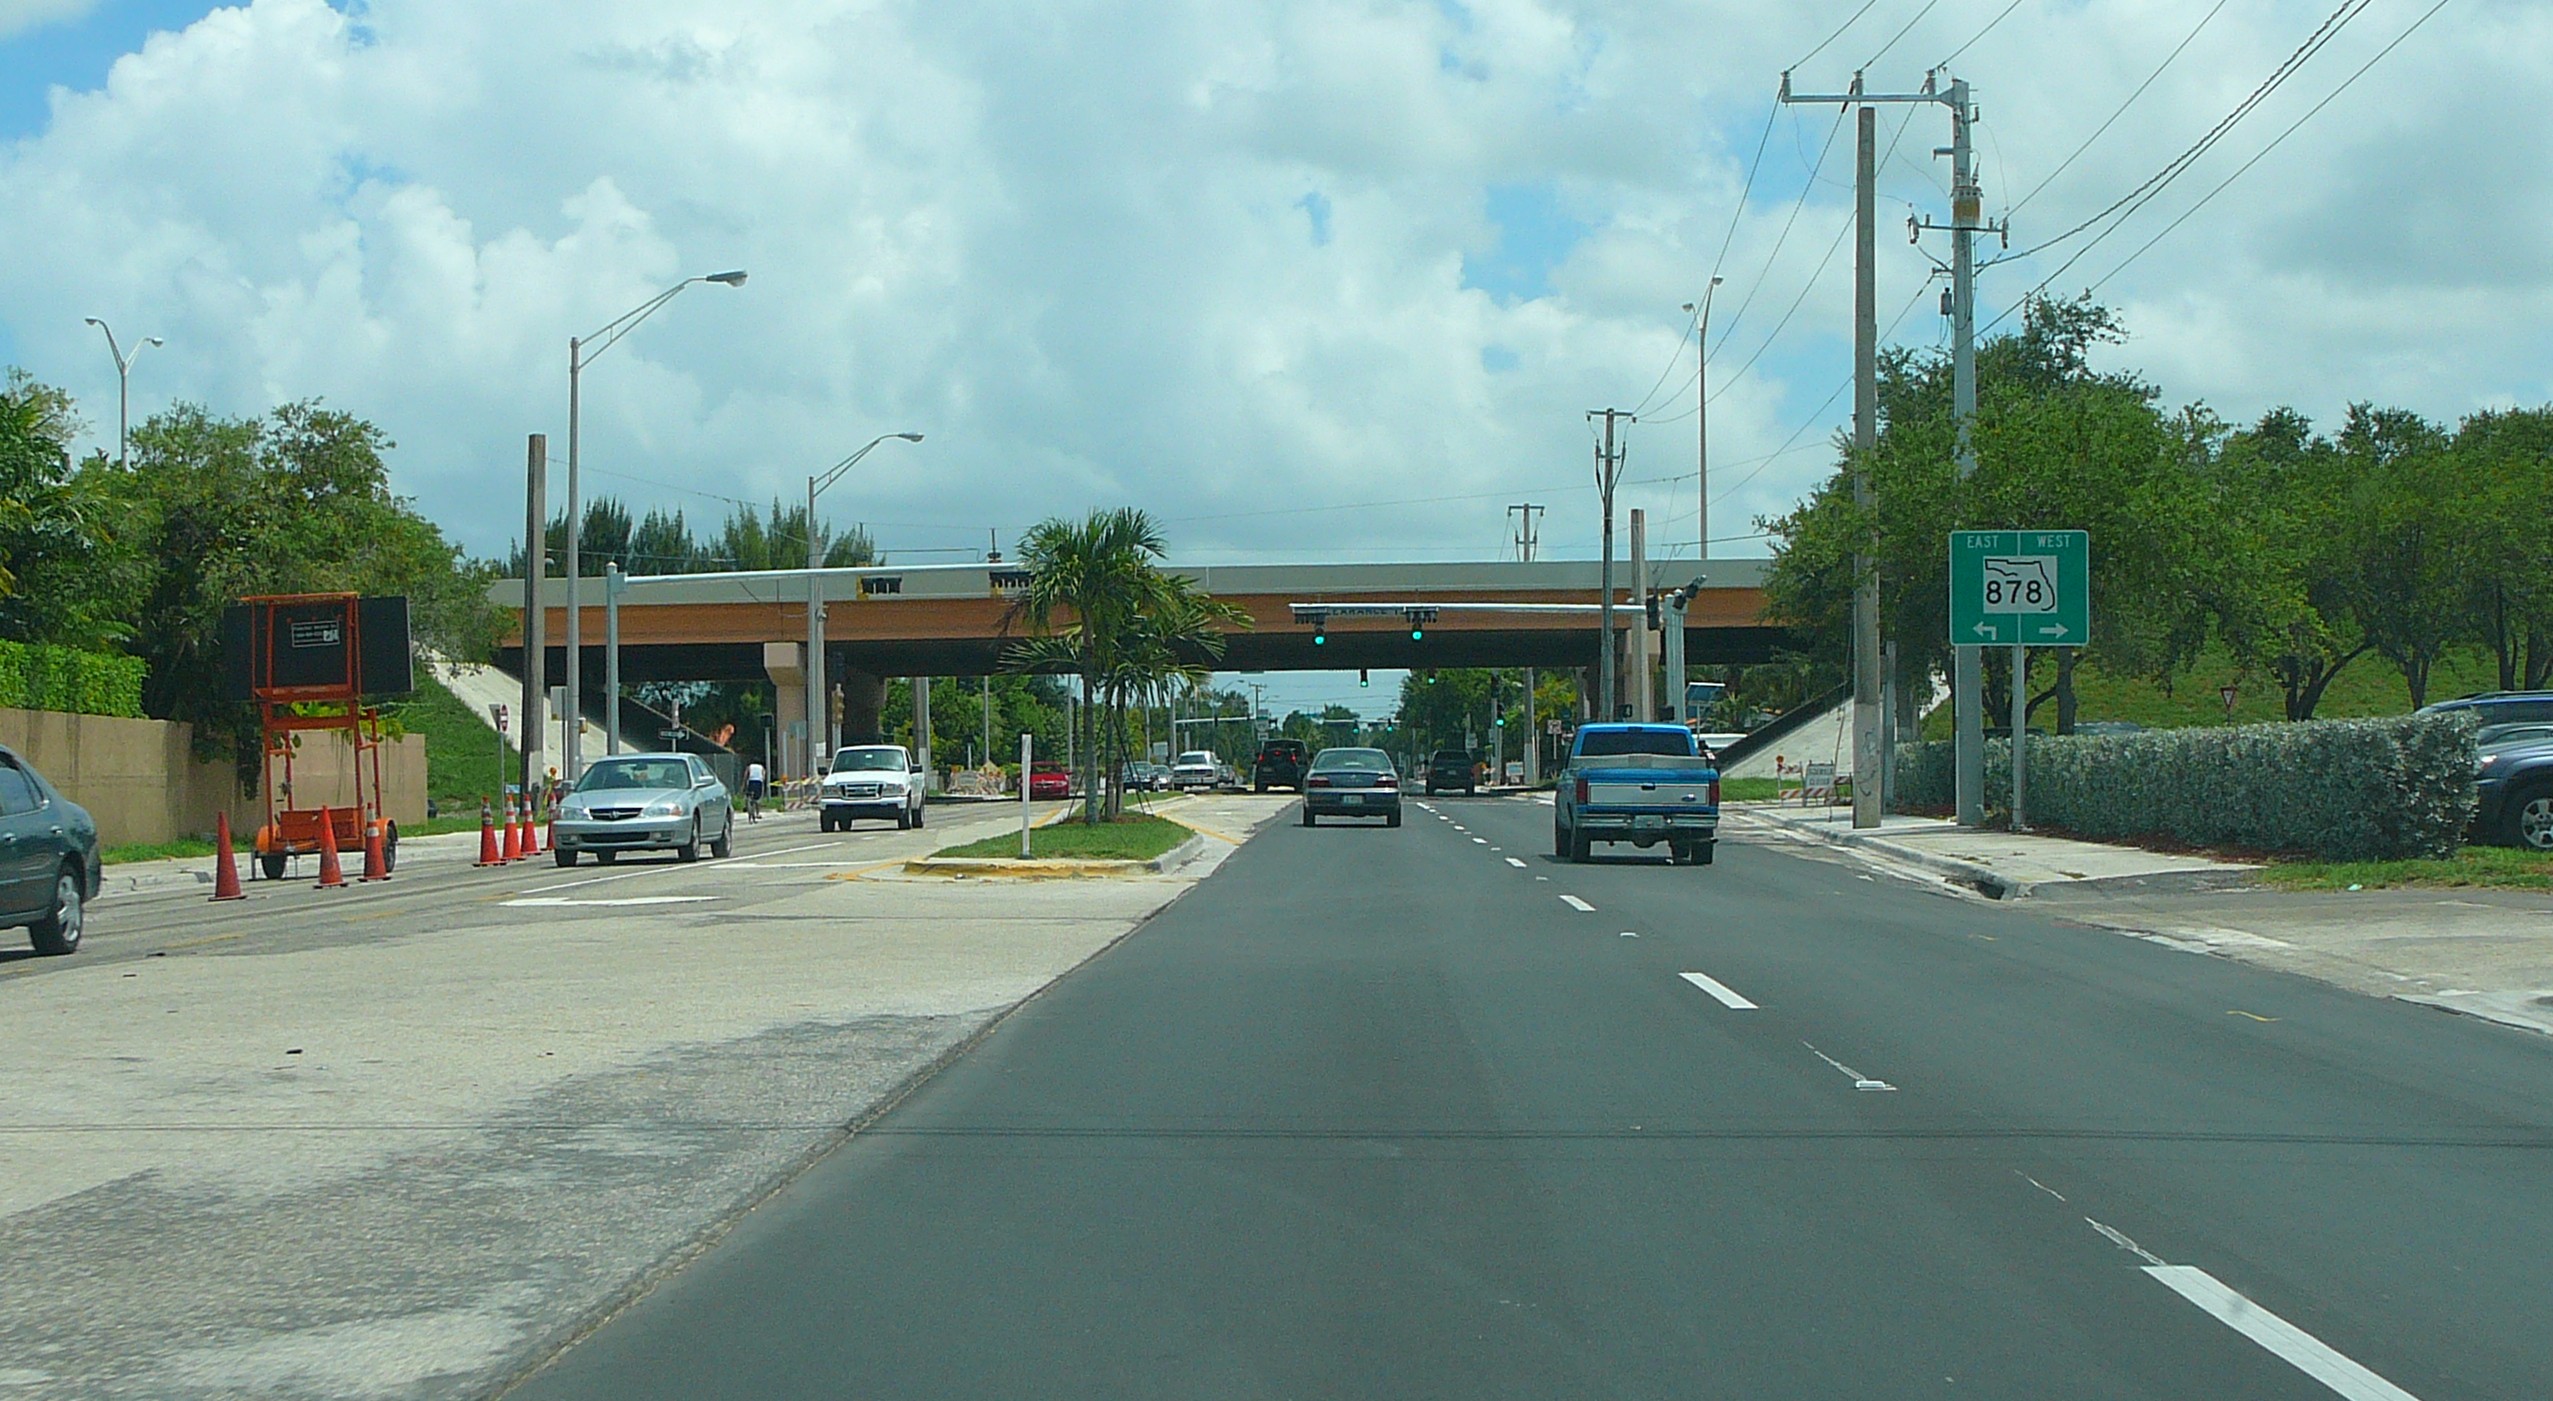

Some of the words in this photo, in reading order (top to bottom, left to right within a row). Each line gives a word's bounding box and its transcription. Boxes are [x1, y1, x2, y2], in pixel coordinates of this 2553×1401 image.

[1967, 535, 1998, 548] EAST
[2037, 535, 2071, 548] WEST
[1986, 580, 2042, 604] 878
